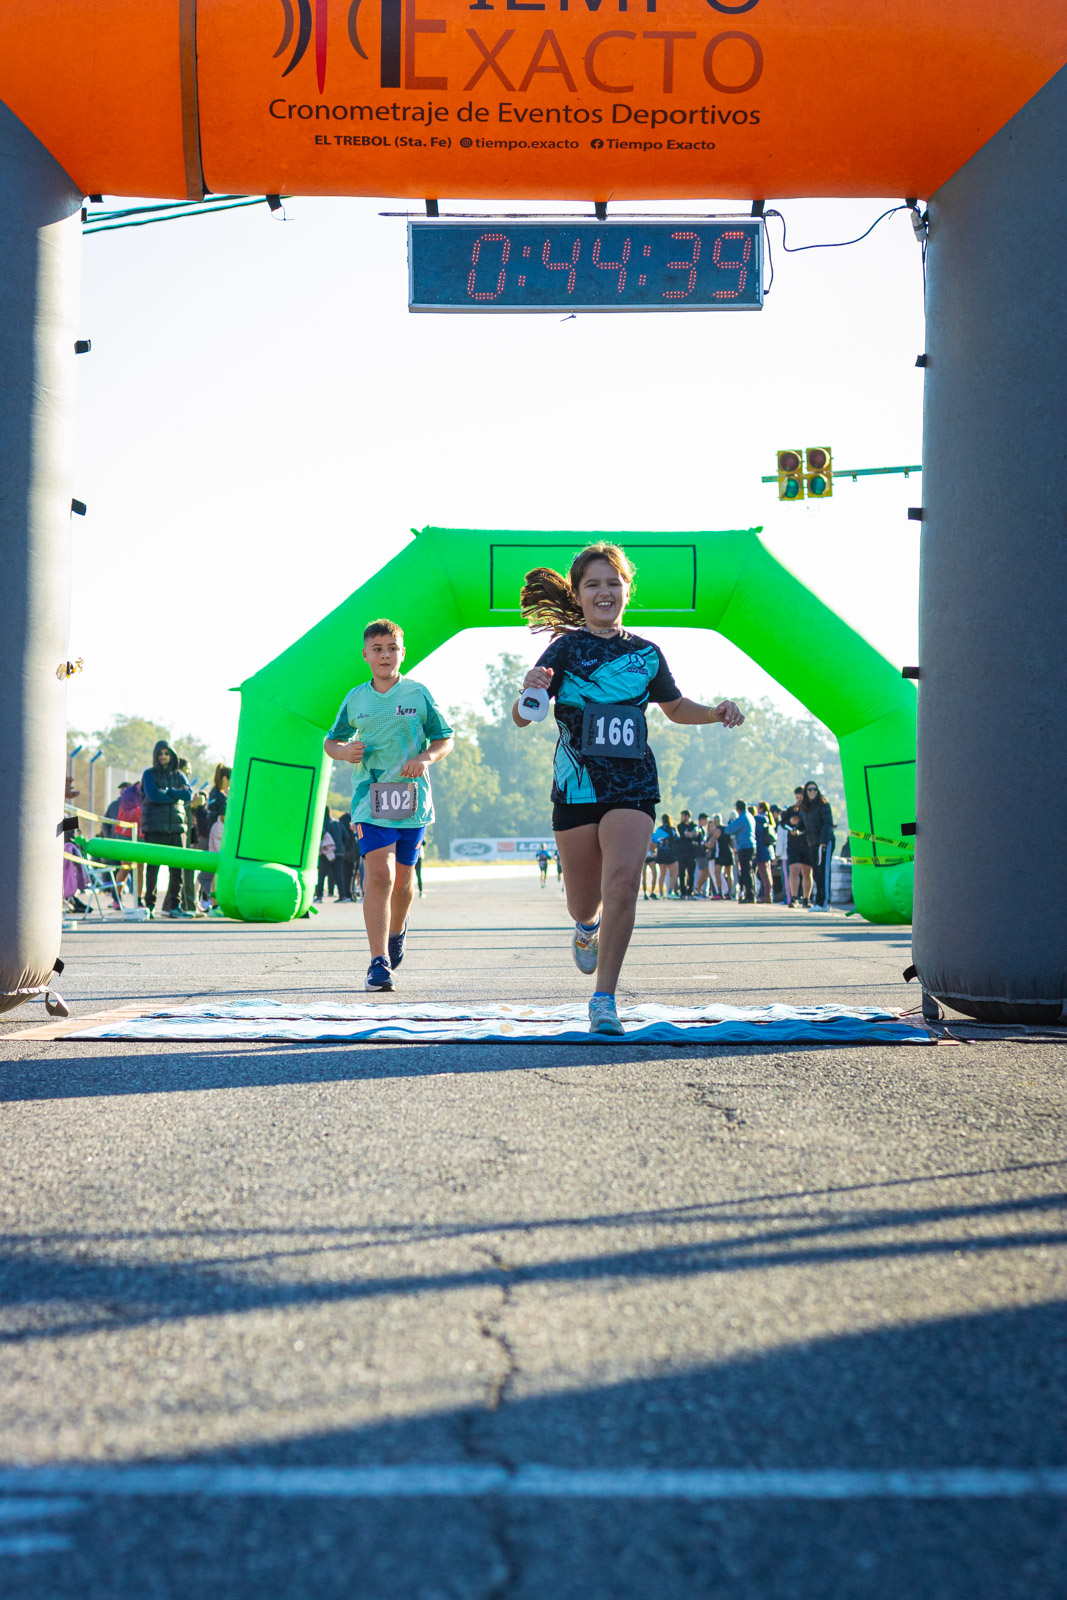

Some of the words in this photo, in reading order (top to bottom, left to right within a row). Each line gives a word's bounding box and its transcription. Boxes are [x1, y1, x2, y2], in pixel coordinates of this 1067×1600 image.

[268, 98, 449, 127] Cronometraje
[456, 101, 490, 122] de
[499, 102, 603, 124] Eventos
[612, 103, 761, 129] Deportivos
[314, 135, 332, 146] EL
[333, 135, 391, 147] TREBOL
[394, 136, 427, 148] (Sta.
[430, 136, 452, 148] Fe)
[475, 137, 579, 151] tiempo.exacto
[605, 138, 663, 151] Tiempo
[666, 139, 716, 150] Exacto
[466, 231, 752, 300] 0:44:39
[595, 716, 635, 746] 166
[381, 790, 411, 811] 102
